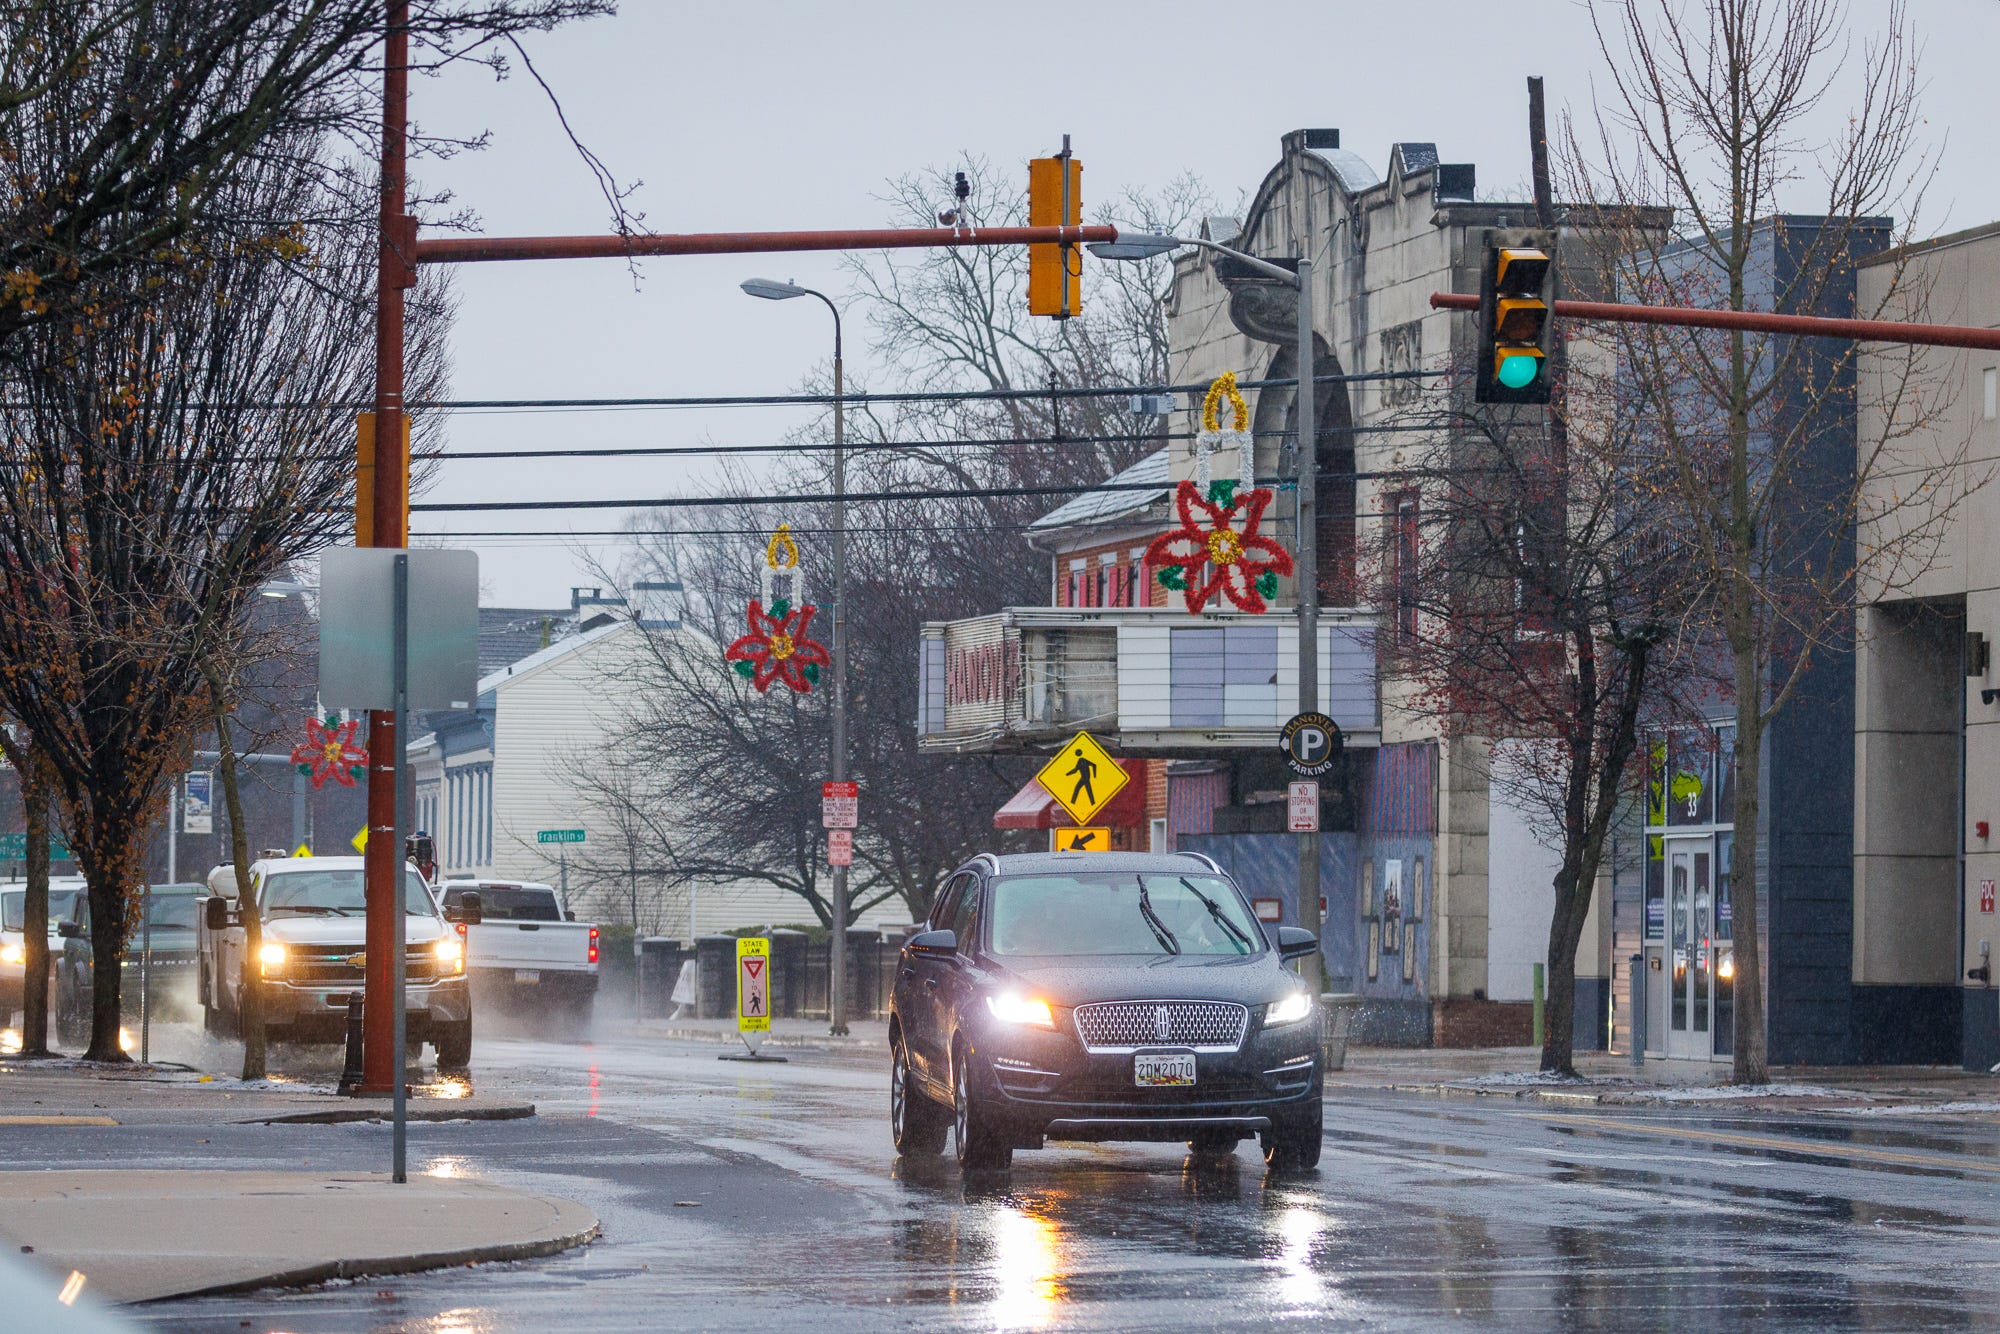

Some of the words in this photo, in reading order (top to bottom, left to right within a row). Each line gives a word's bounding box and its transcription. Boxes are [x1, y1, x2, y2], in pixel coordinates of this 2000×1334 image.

[1284, 714, 1336, 735] HANOVER
[1301, 729, 1324, 760] P
[1288, 760, 1333, 776] PARKING
[1298, 787, 1308, 796] NO
[1291, 796, 1315, 806] STOPPING
[1687, 792, 1697, 818] 33
[538, 831, 576, 841] Franklin
[1981, 881, 1994, 899] FDC
[1138, 1062, 1193, 1079] 2DM2070
